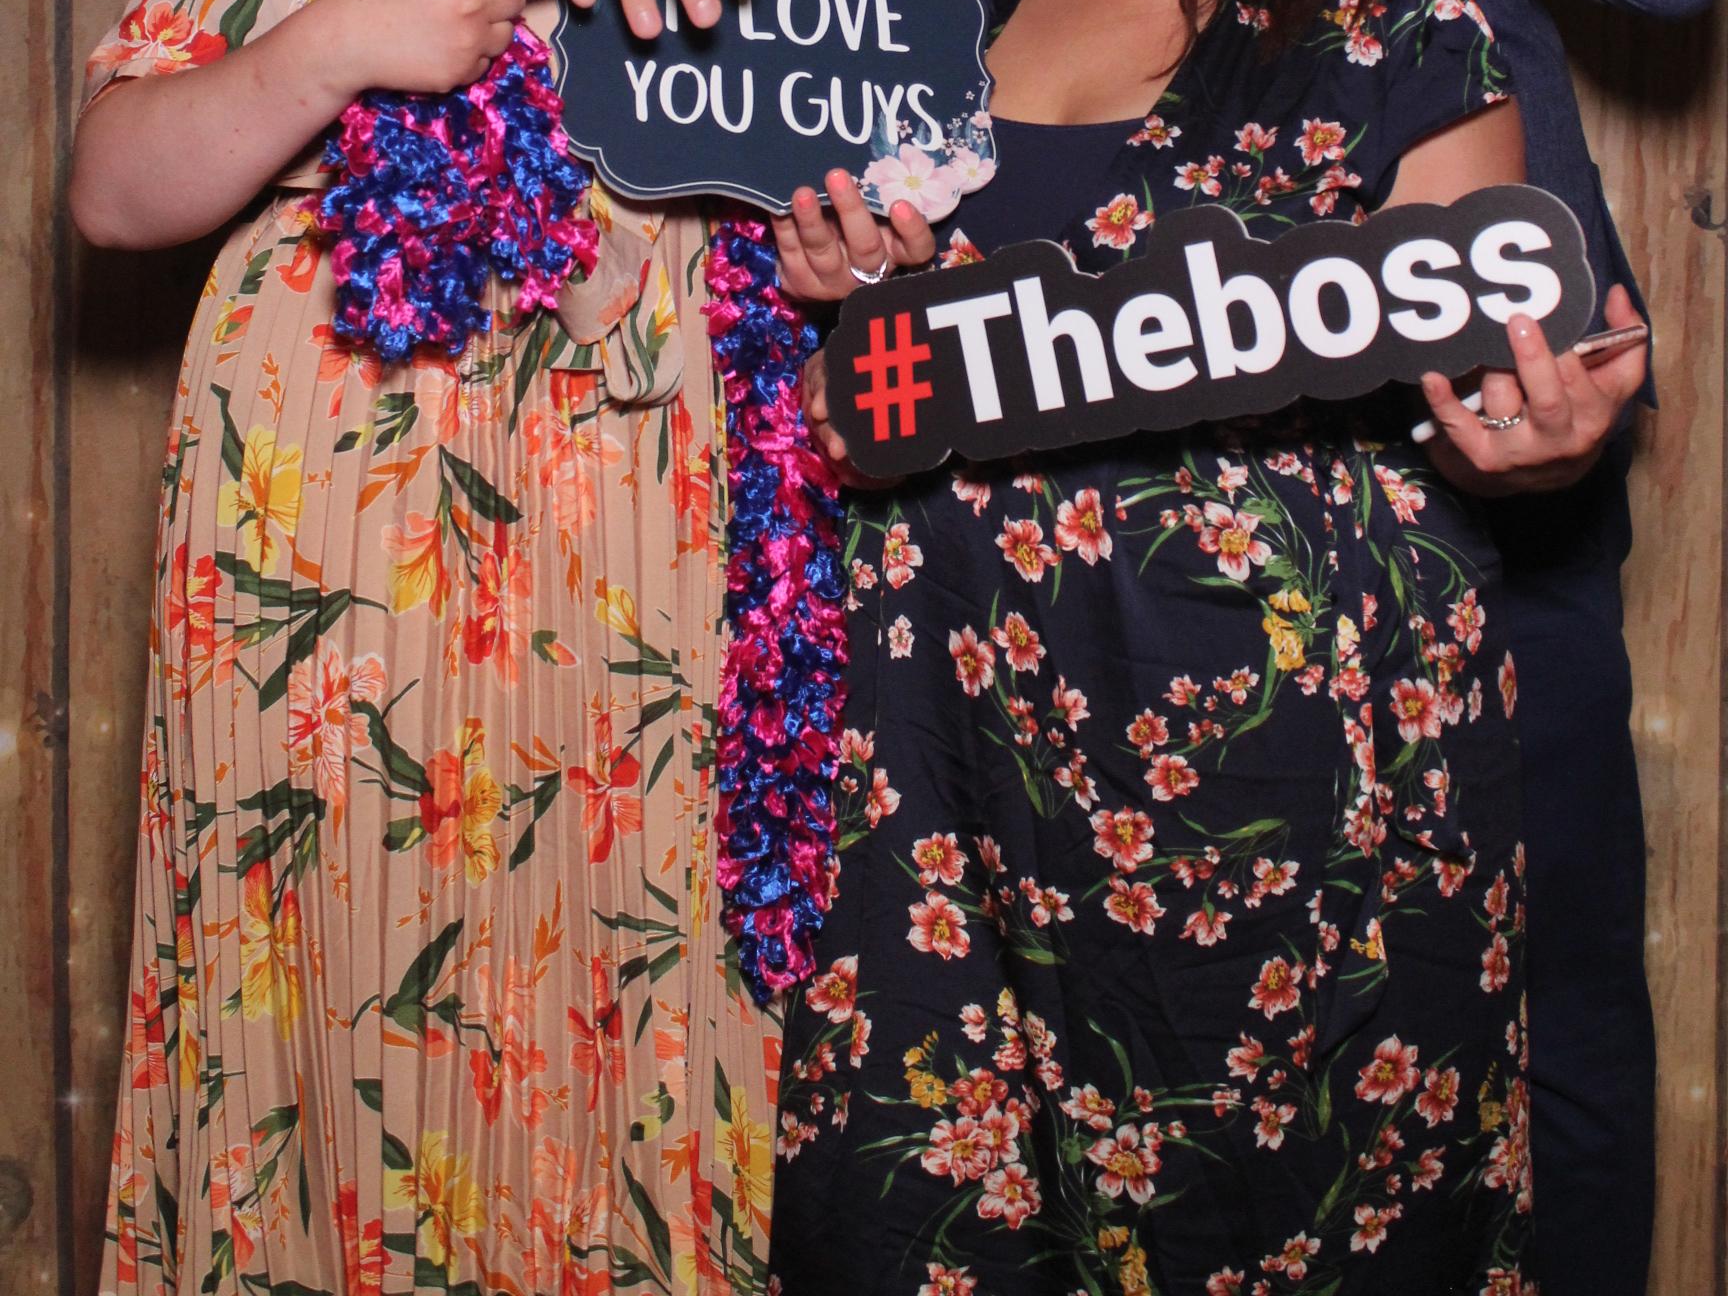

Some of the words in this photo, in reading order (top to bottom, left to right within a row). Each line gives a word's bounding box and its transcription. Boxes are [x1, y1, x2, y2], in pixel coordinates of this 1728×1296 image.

[624, 59, 754, 134] YOU
[779, 71, 944, 151] GUYS
[852, 220, 1562, 443] #Theboss
